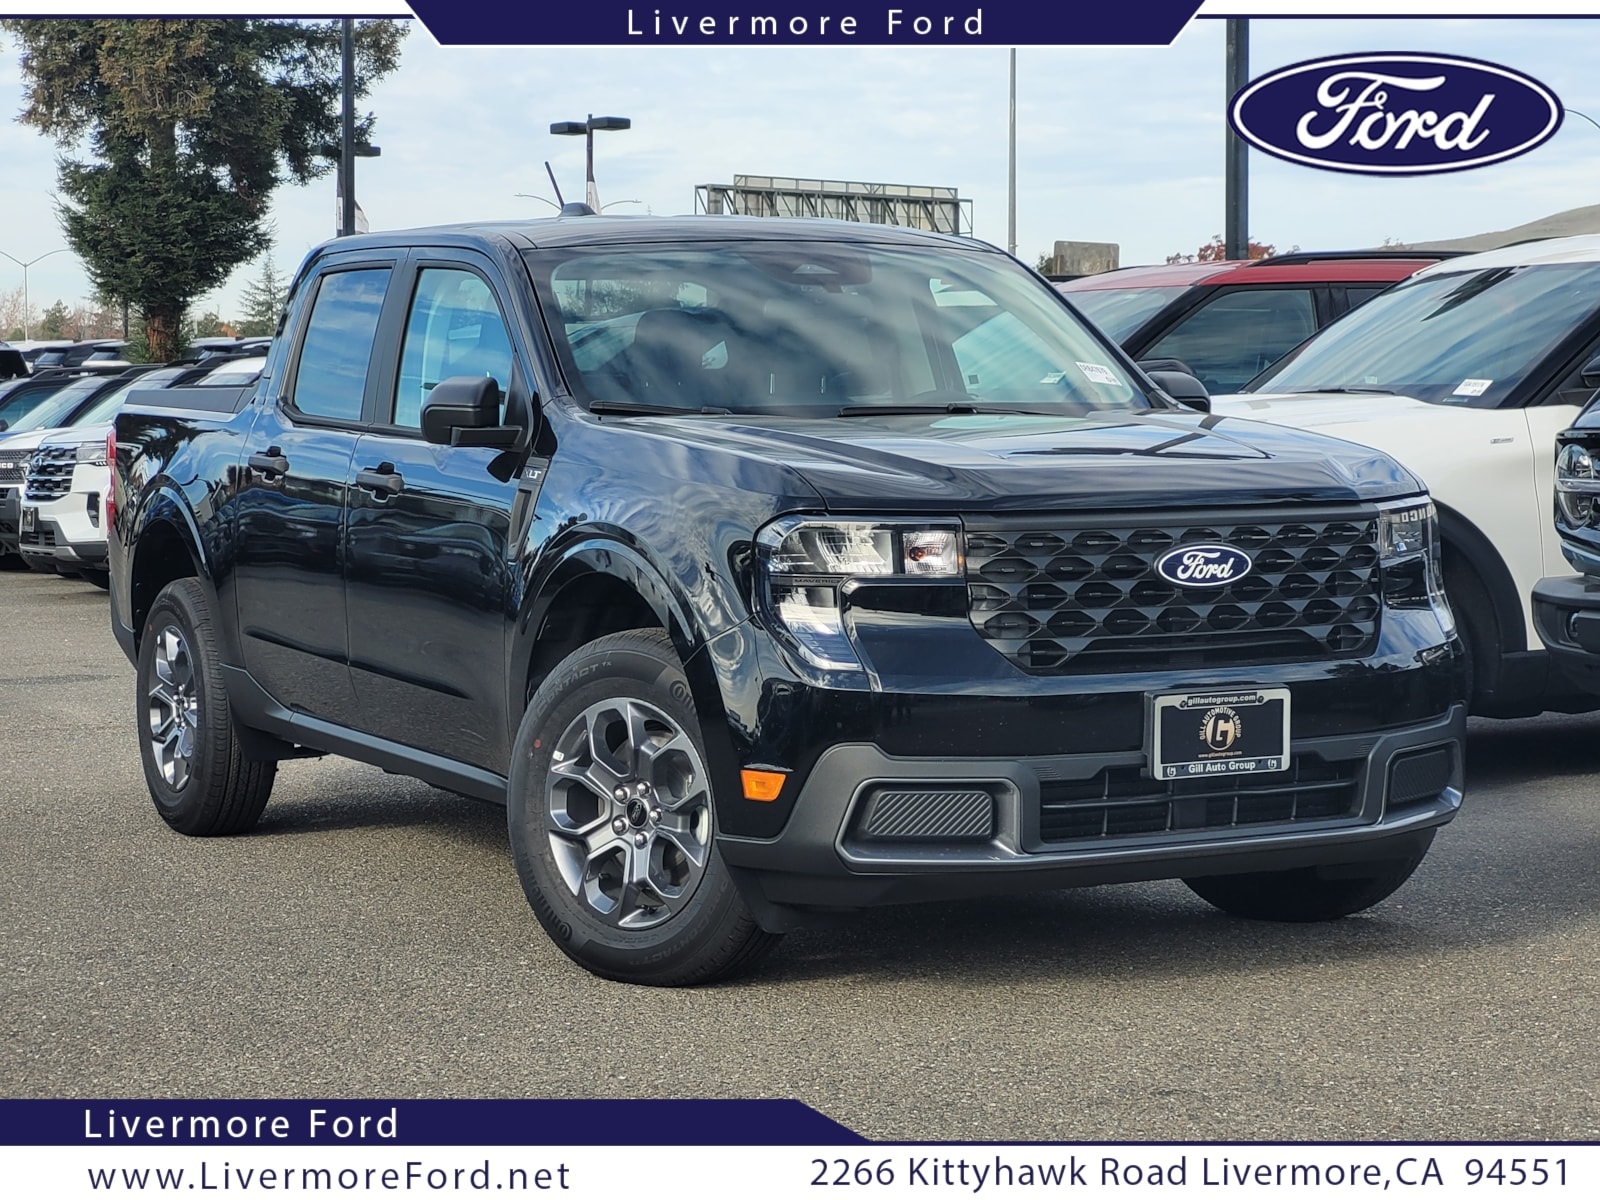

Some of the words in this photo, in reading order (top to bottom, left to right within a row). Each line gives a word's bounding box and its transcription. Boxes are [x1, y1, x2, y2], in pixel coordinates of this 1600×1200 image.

[1177, 551, 1235, 579] Ford
[1188, 695, 1255, 706] gillautogroup.com
[1202, 707, 1235, 725] AUTOMOTIVE
[1199, 725, 1207, 740] GILL
[1233, 715, 1242, 738] GROUP
[1188, 764, 1204, 774] Gill
[1205, 762, 1227, 772] Auto
[1228, 760, 1256, 772] Group
